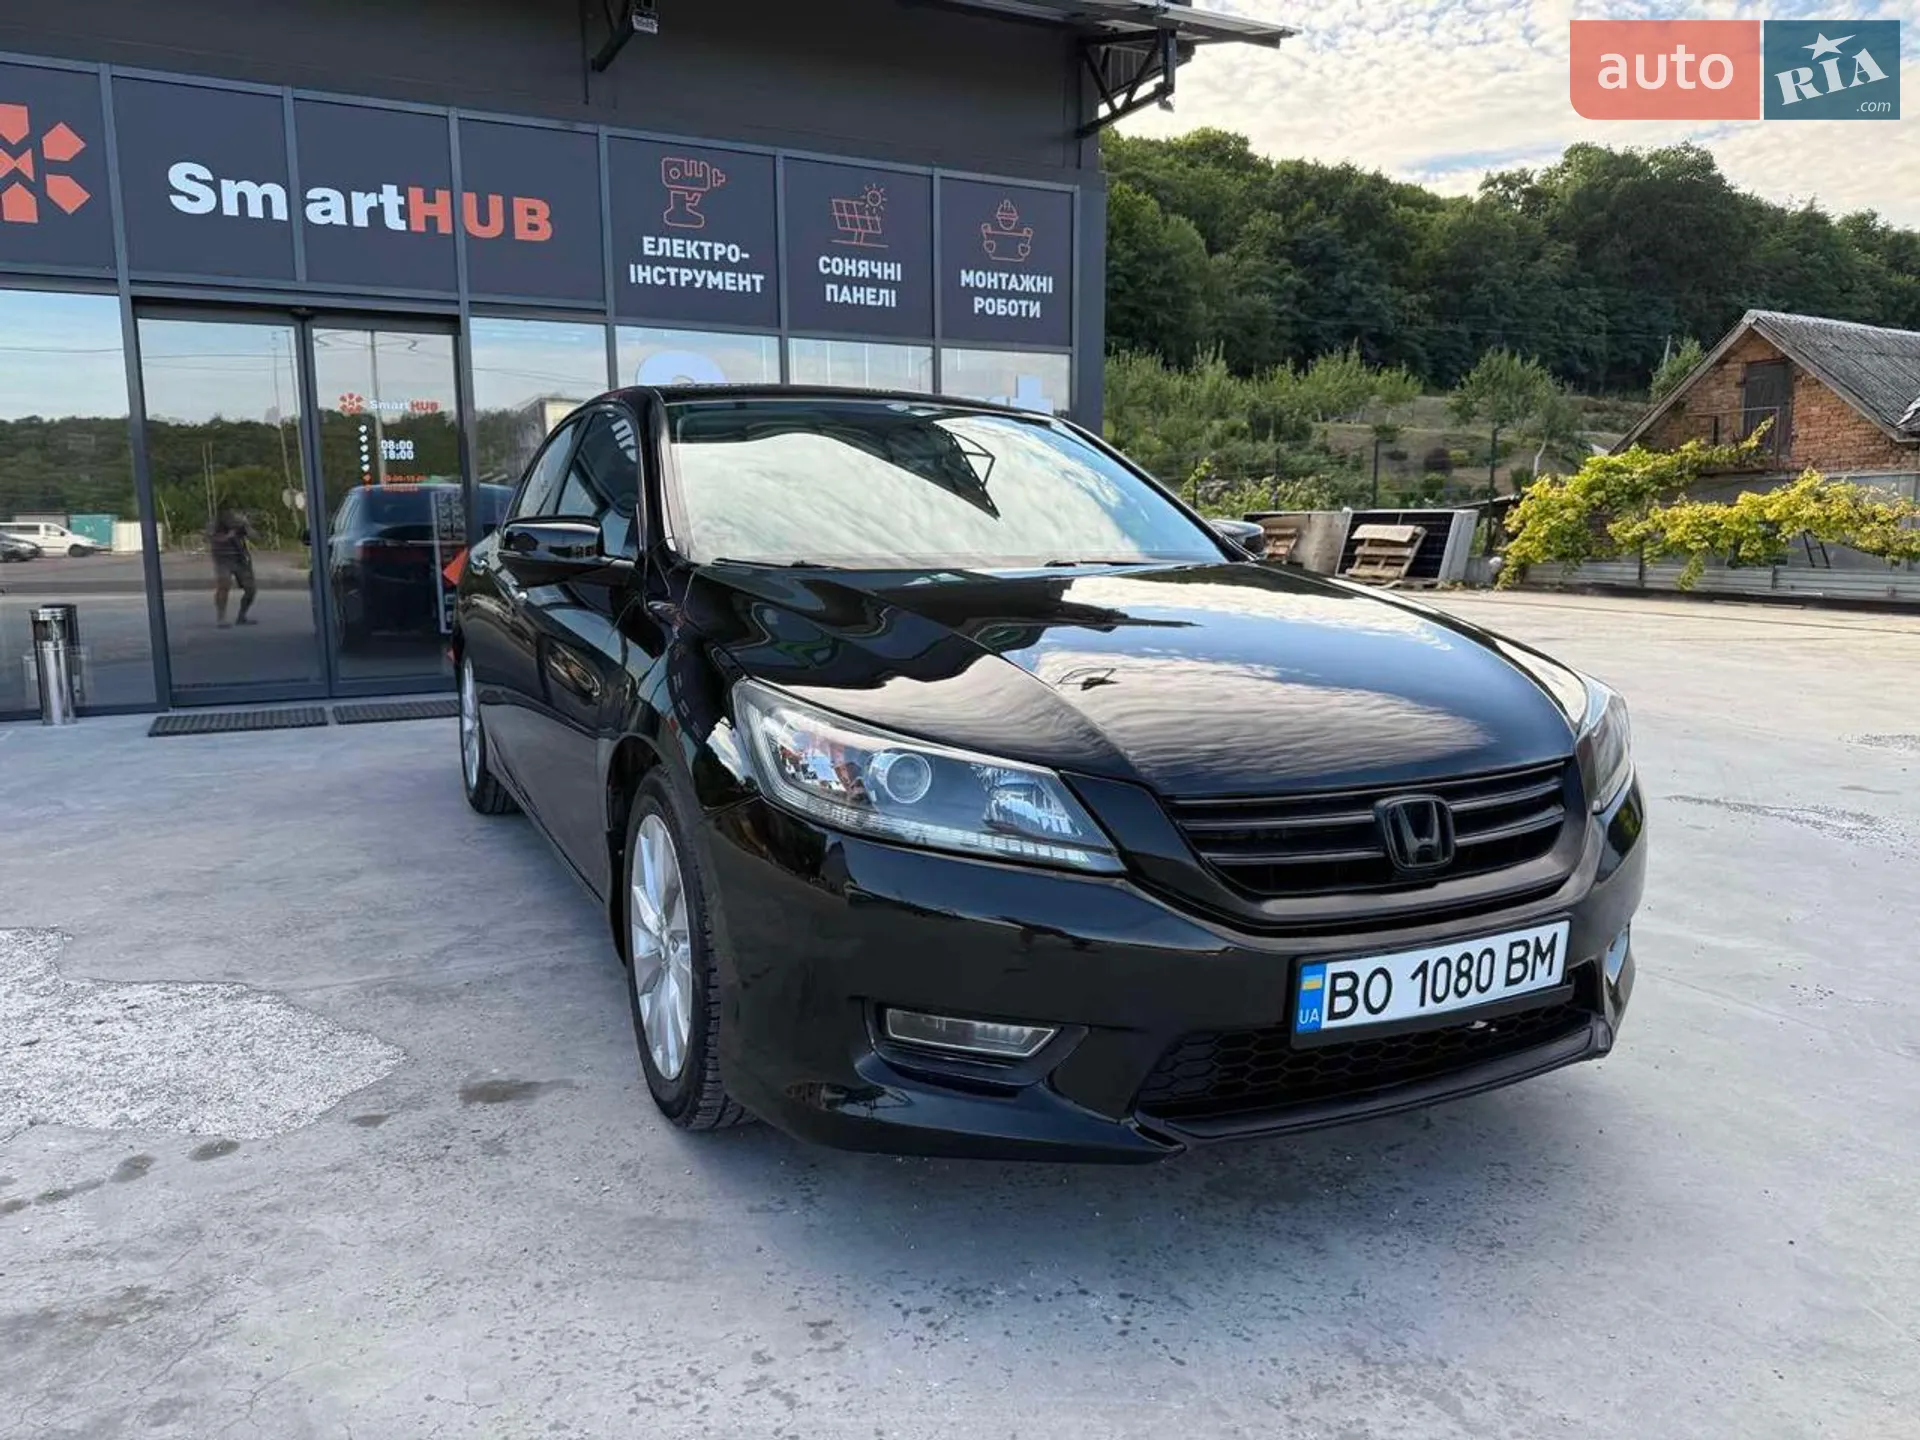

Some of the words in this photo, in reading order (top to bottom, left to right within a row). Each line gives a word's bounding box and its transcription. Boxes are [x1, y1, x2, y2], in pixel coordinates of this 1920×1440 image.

[642, 235, 750, 264] ЕЛЕКТРО-
[629, 263, 765, 293] ІНСТРУМЕНТ
[818, 255, 902, 282] СОНЯЧНІ
[960, 269, 1053, 294] МОНТАЖНІ
[825, 283, 897, 308] ПАНЕЛІ
[973, 296, 1041, 318] РОБОТИ
[1410, 948, 1496, 1008] 1080
[1299, 1009, 1320, 1024] UA
